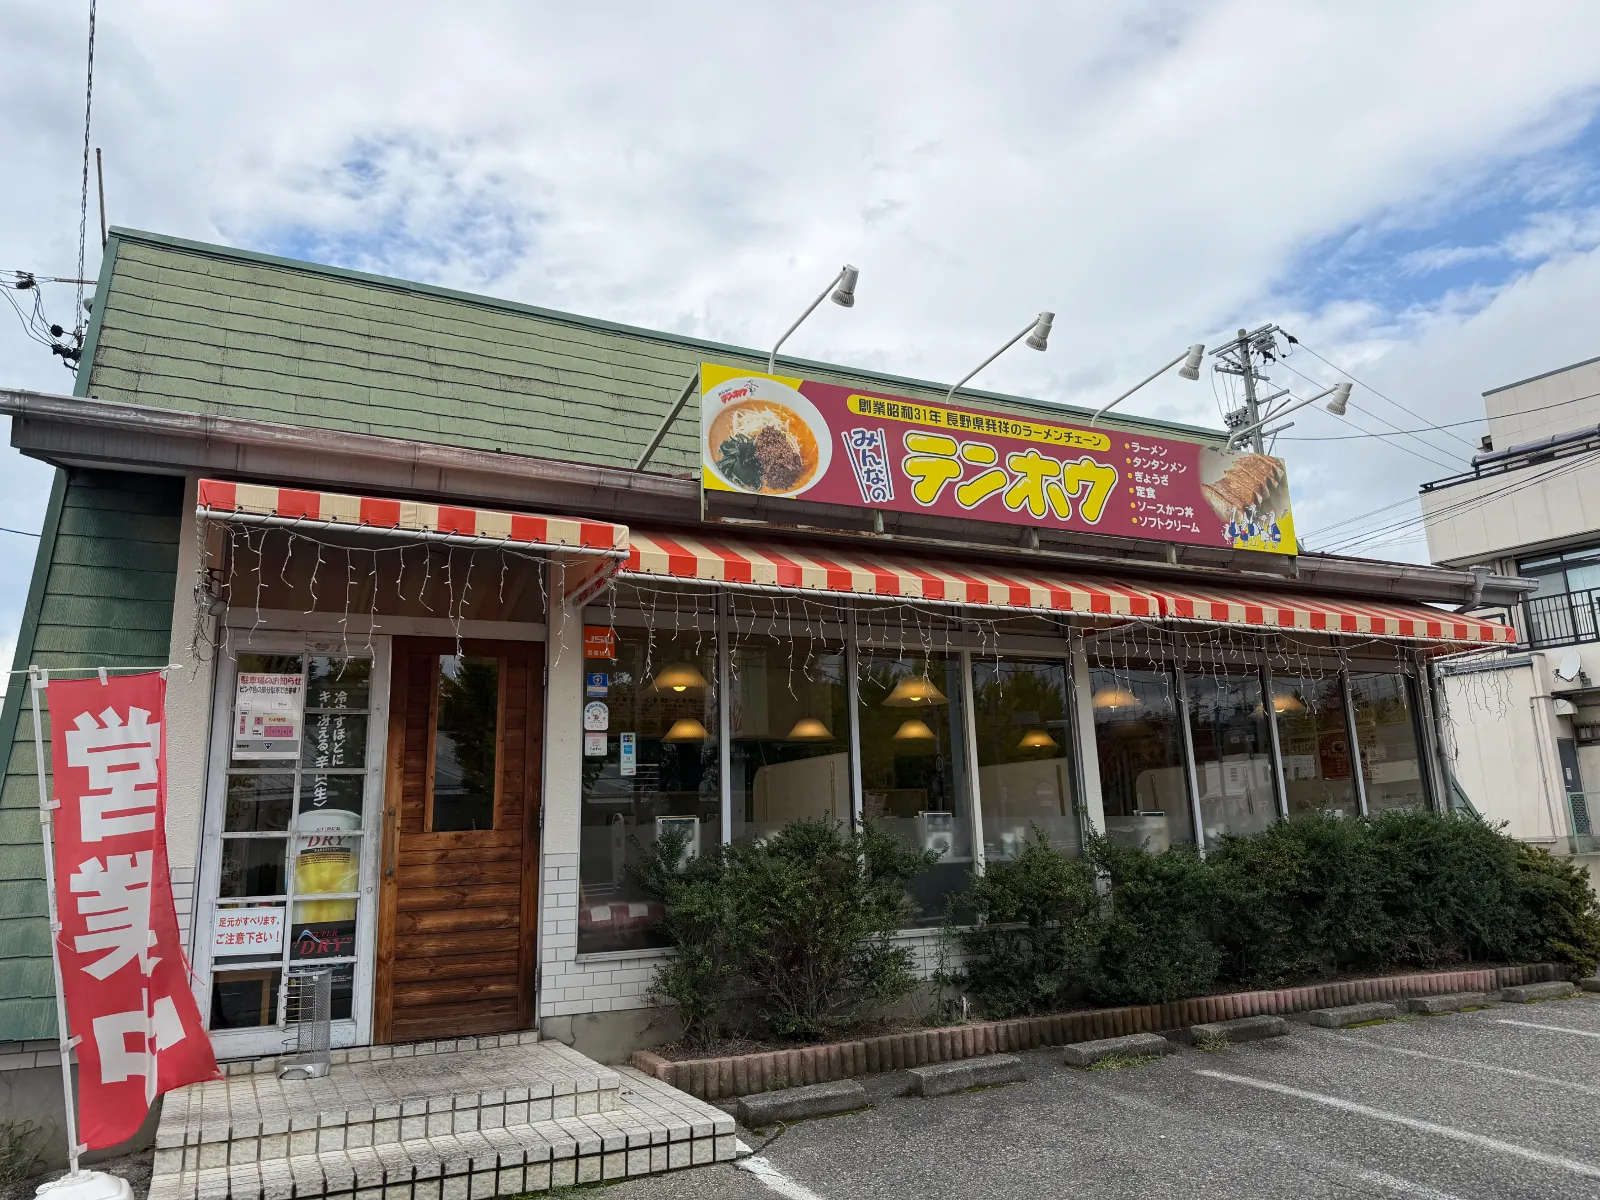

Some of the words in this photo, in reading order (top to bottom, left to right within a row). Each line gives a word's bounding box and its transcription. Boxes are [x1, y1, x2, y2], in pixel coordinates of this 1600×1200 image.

[858, 398, 942, 425] 創業昭和31年
[946, 412, 1102, 447] 長野県発祥のラーメンチェーン
[1131, 441, 1168, 457] ラーメン
[852, 429, 888, 502] みんなの
[1133, 456, 1187, 474] タンタンメン
[902, 430, 1117, 525] テンホウ
[1135, 470, 1169, 487] ぎょうざ
[1135, 486, 1156, 500] 定食
[1137, 501, 1195, 518] ソースかつ丼
[1139, 515, 1201, 534] ソフトクリーム
[240, 675, 302, 686] 駐車場のお知らせ
[65, 706, 187, 1109] 営業中
[215, 931, 280, 945] ご注意下さい！
[311, 929, 339, 939] SUPER
